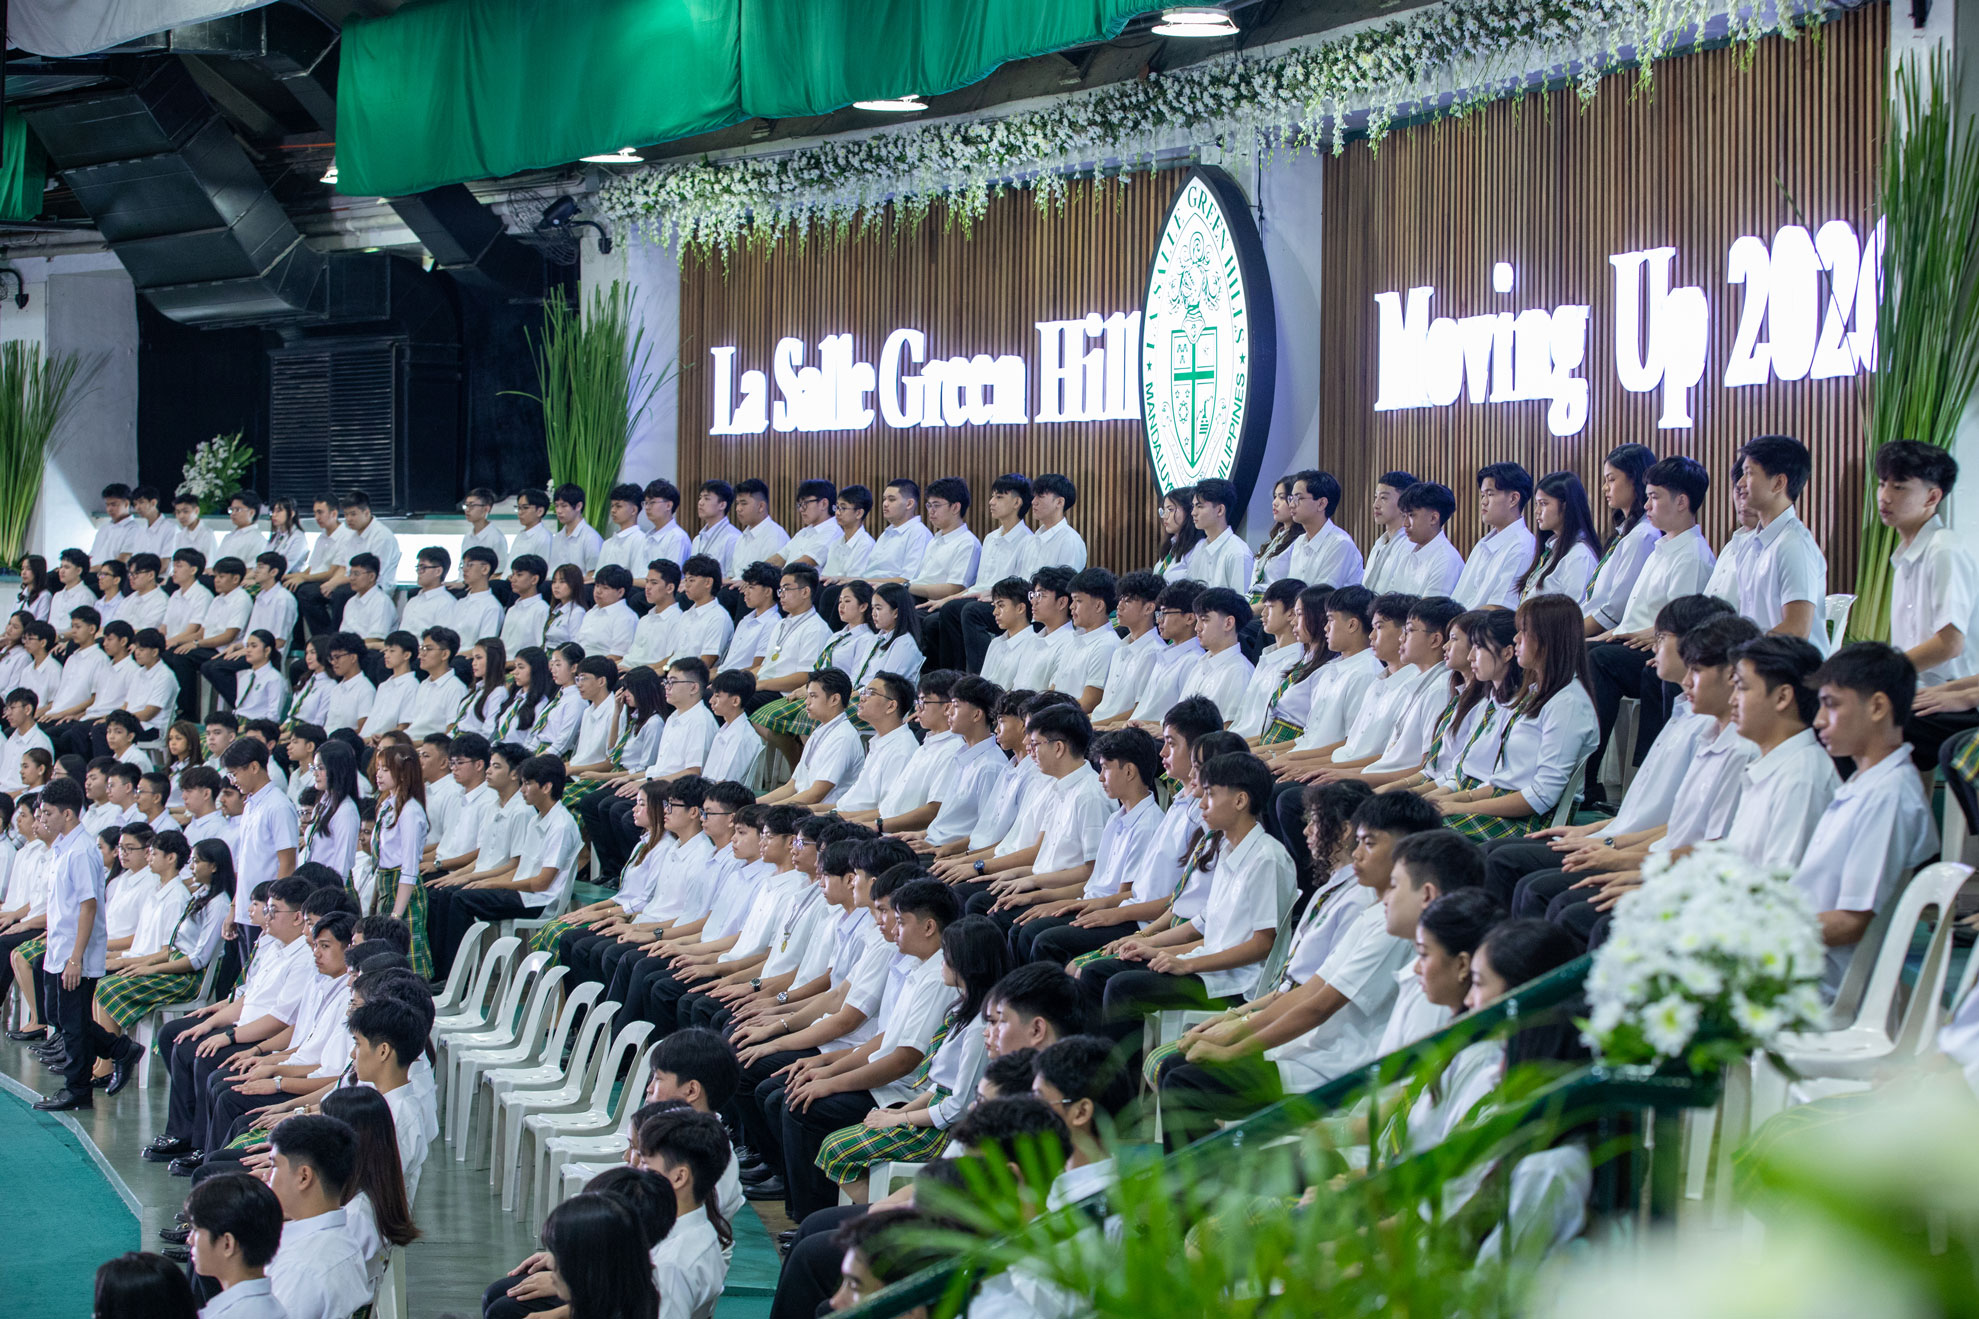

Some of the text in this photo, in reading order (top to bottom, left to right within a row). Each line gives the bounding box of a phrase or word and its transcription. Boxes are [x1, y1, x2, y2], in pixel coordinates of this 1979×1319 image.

[1187, 185, 1229, 251] GREEN
[1224, 254, 1245, 344] HILLS
[709, 310, 1142, 436] La Salle Green Hill
[1374, 261, 1591, 437] Moving
[1609, 245, 1710, 429] Up
[1145, 380, 1174, 491] MANDALUY
[1217, 371, 1246, 480] ILIPPINES
